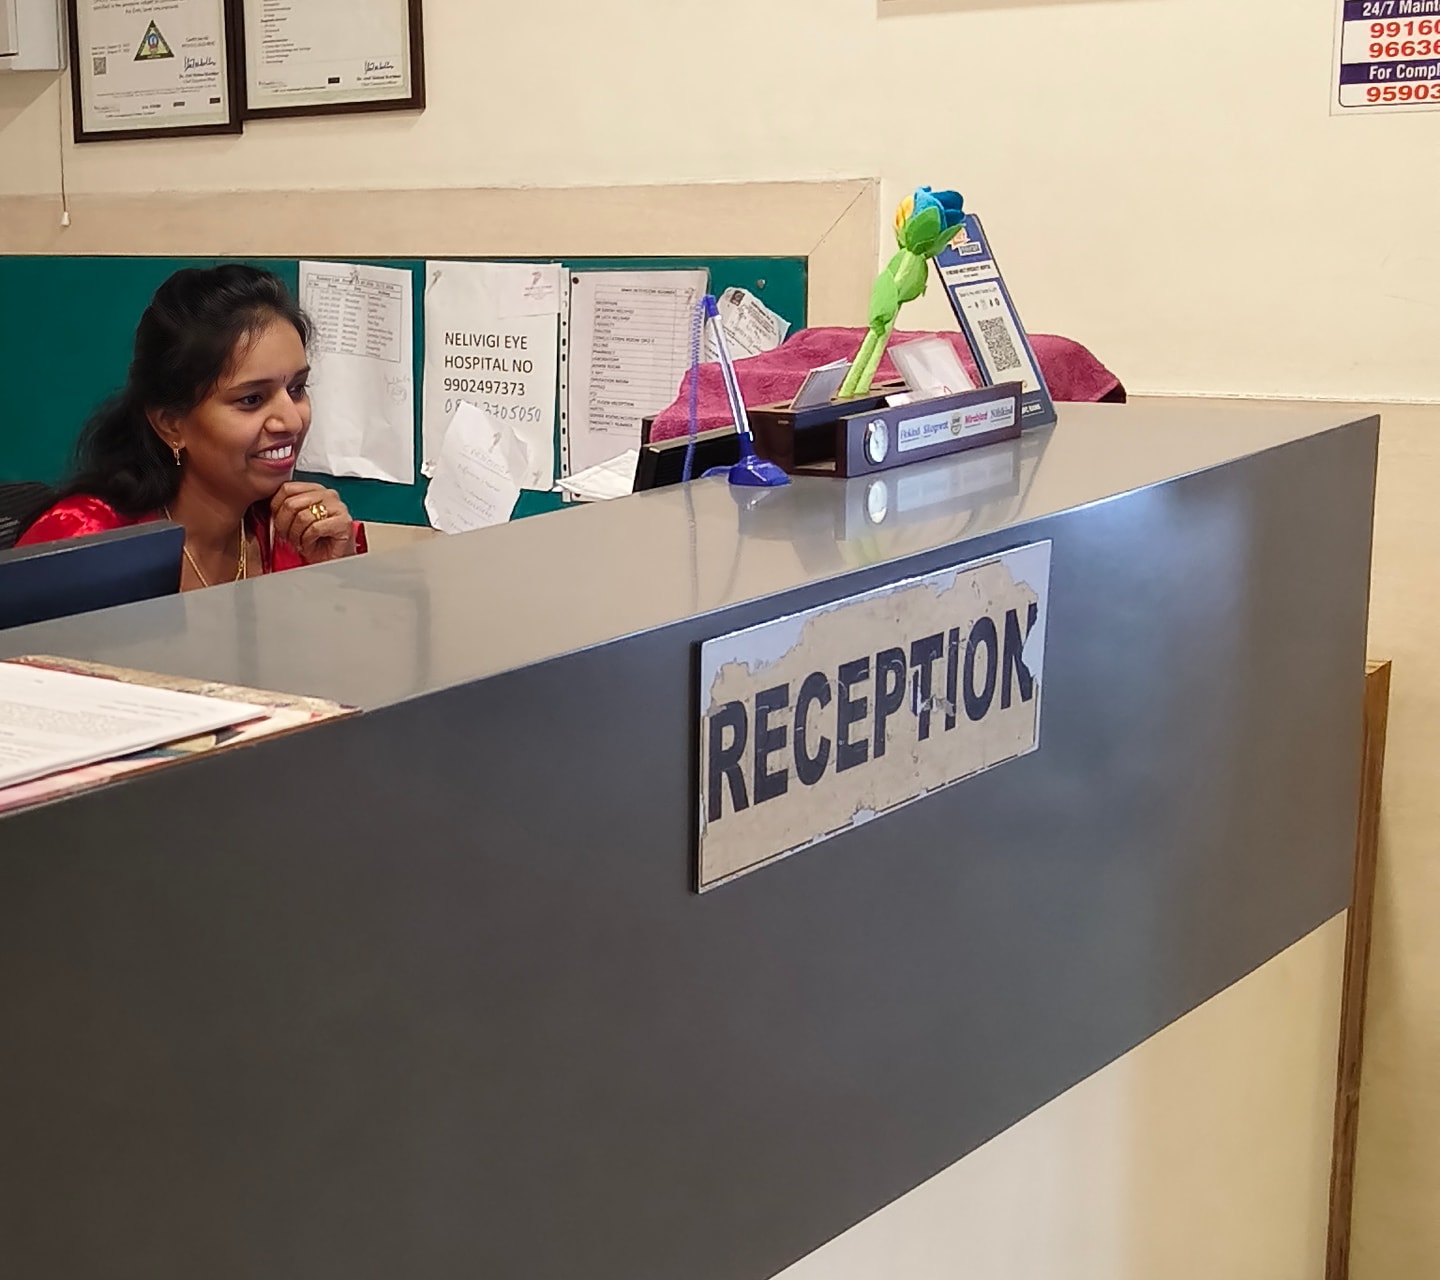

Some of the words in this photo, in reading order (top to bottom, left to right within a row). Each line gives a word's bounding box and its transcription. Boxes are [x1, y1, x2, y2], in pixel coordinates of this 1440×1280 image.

[1363, 0, 1395, 17] 24/7
[1369, 66, 1392, 80] For
[1366, 84, 1440, 102] 95903
[445, 332, 500, 348] NELIVIGI
[505, 336, 528, 350] EYE
[444, 356, 508, 372] HOSPITAL
[513, 360, 533, 373] NO
[444, 378, 525, 396] 9902497373
[708, 602, 1038, 823] RECEPTION
